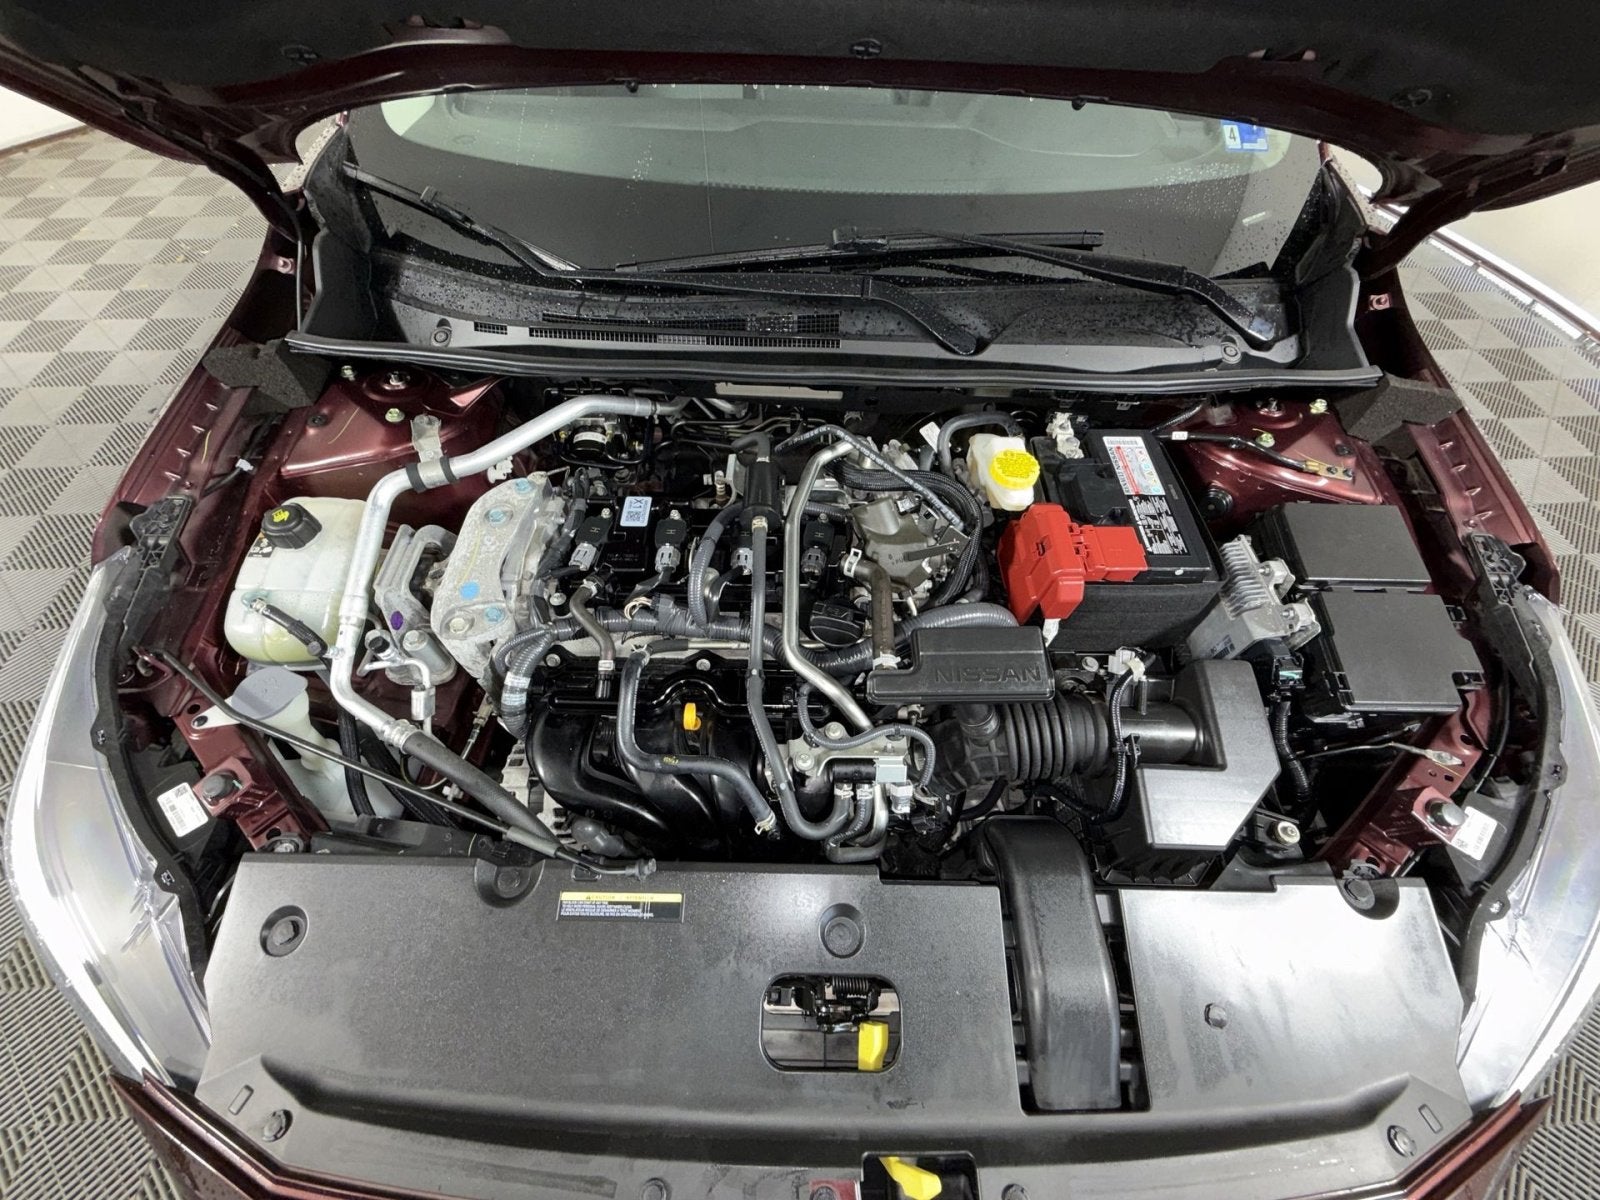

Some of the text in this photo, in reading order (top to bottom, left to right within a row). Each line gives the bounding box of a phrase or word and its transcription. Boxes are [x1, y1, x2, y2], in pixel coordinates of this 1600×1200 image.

[1228, 127, 1236, 142] 4
[1108, 447, 1121, 470] NISSAN
[934, 662, 1043, 684] NISSAN
